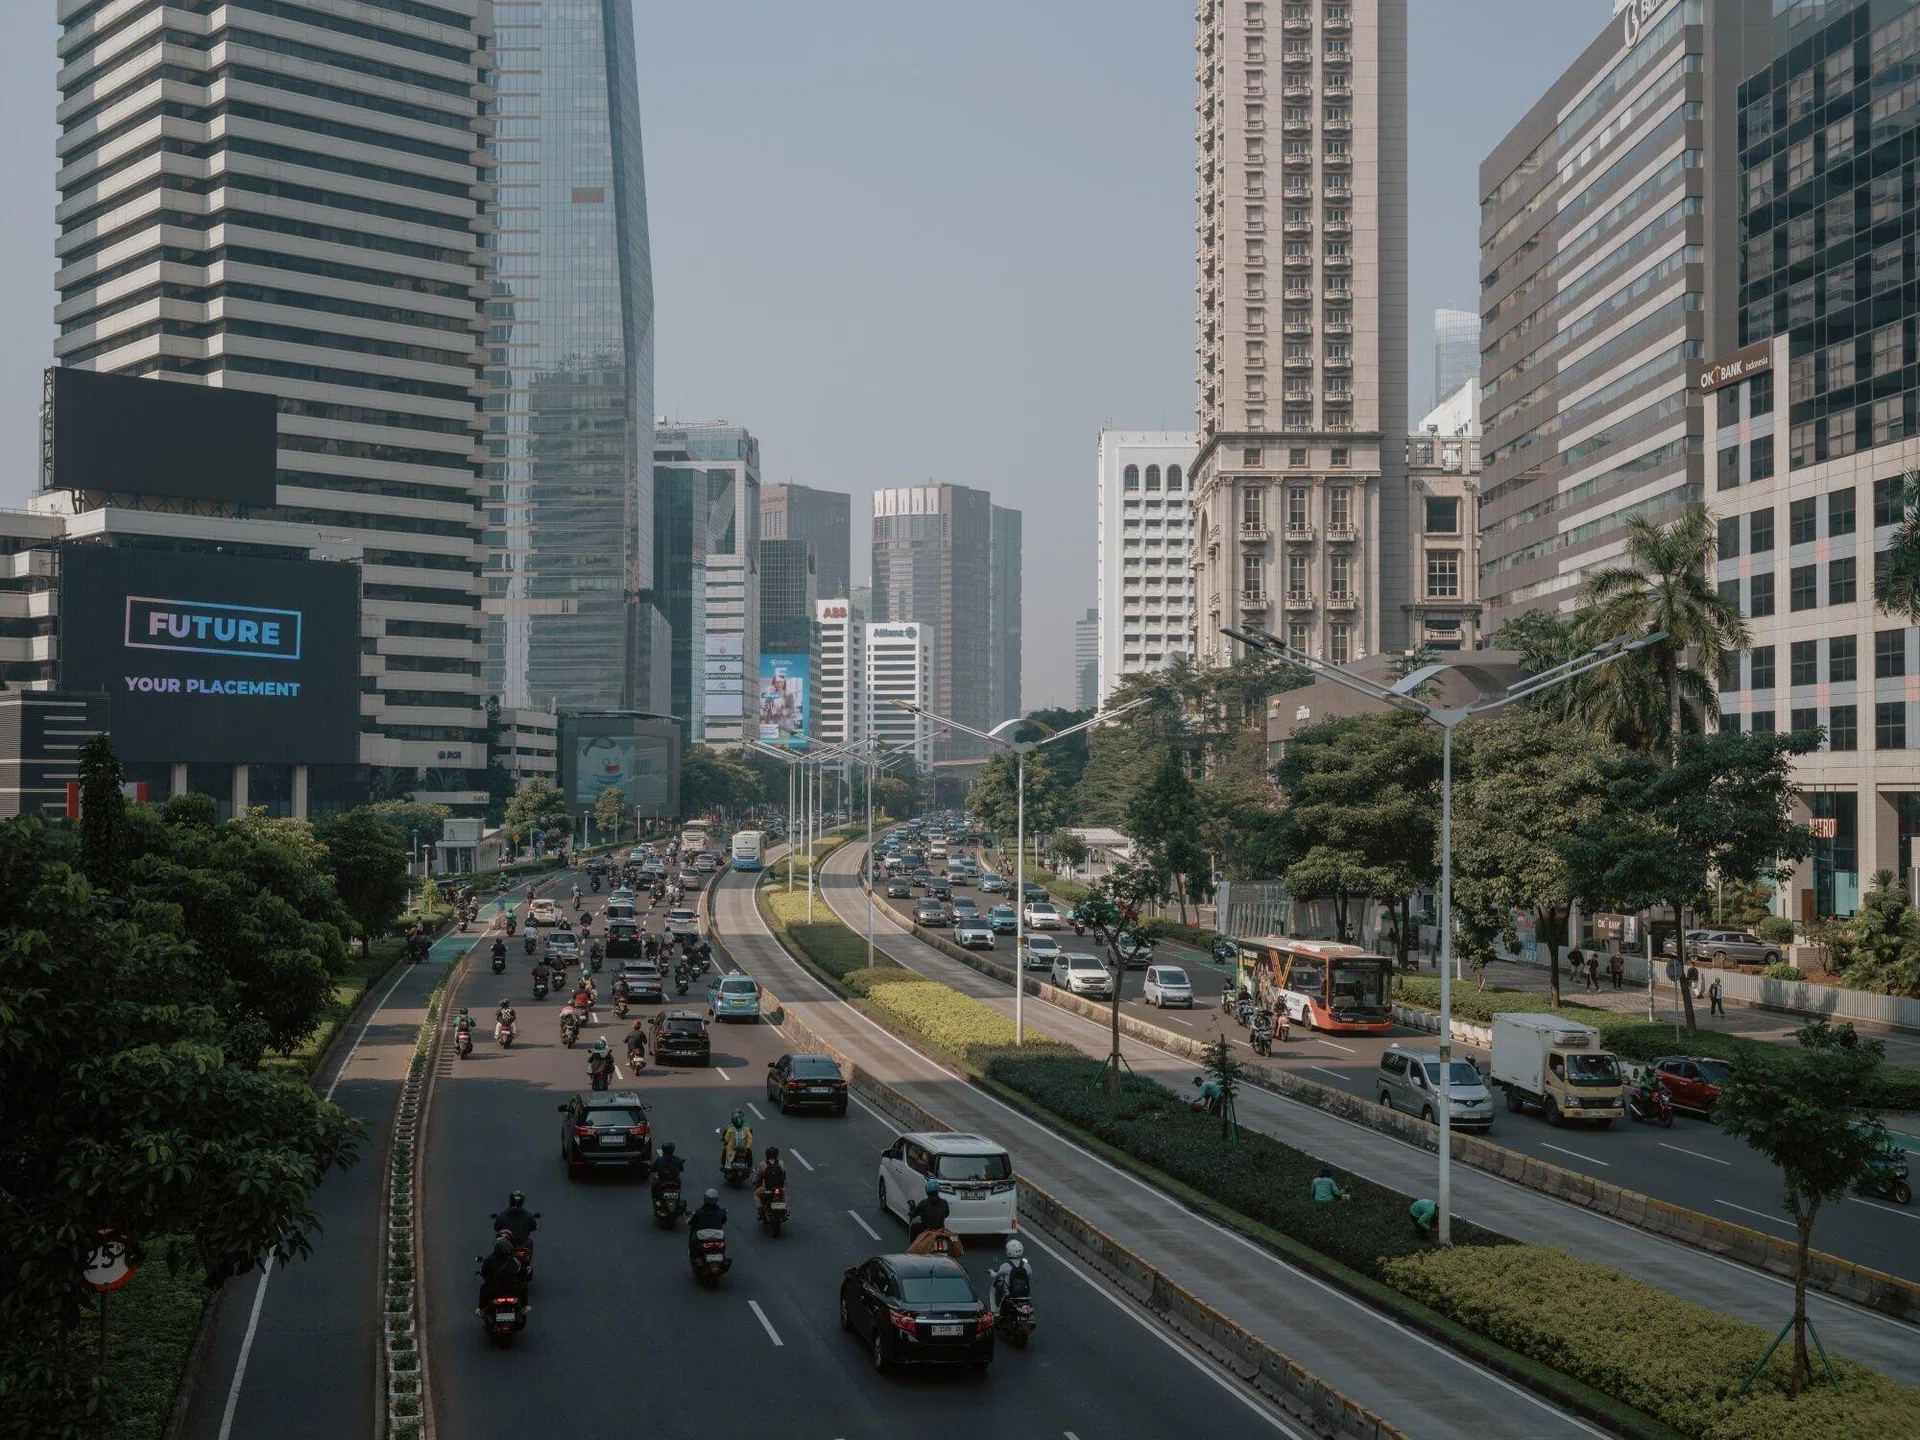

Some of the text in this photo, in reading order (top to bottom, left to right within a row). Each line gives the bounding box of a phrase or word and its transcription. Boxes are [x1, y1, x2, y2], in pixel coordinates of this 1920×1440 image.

[1701, 356, 1769, 387] OK BANK Indonesia
[823, 607, 848, 619] ABB
[149, 612, 280, 645] FUTURE
[873, 628, 905, 638] Allianz
[125, 676, 301, 697] YOUR PLACEMENT
